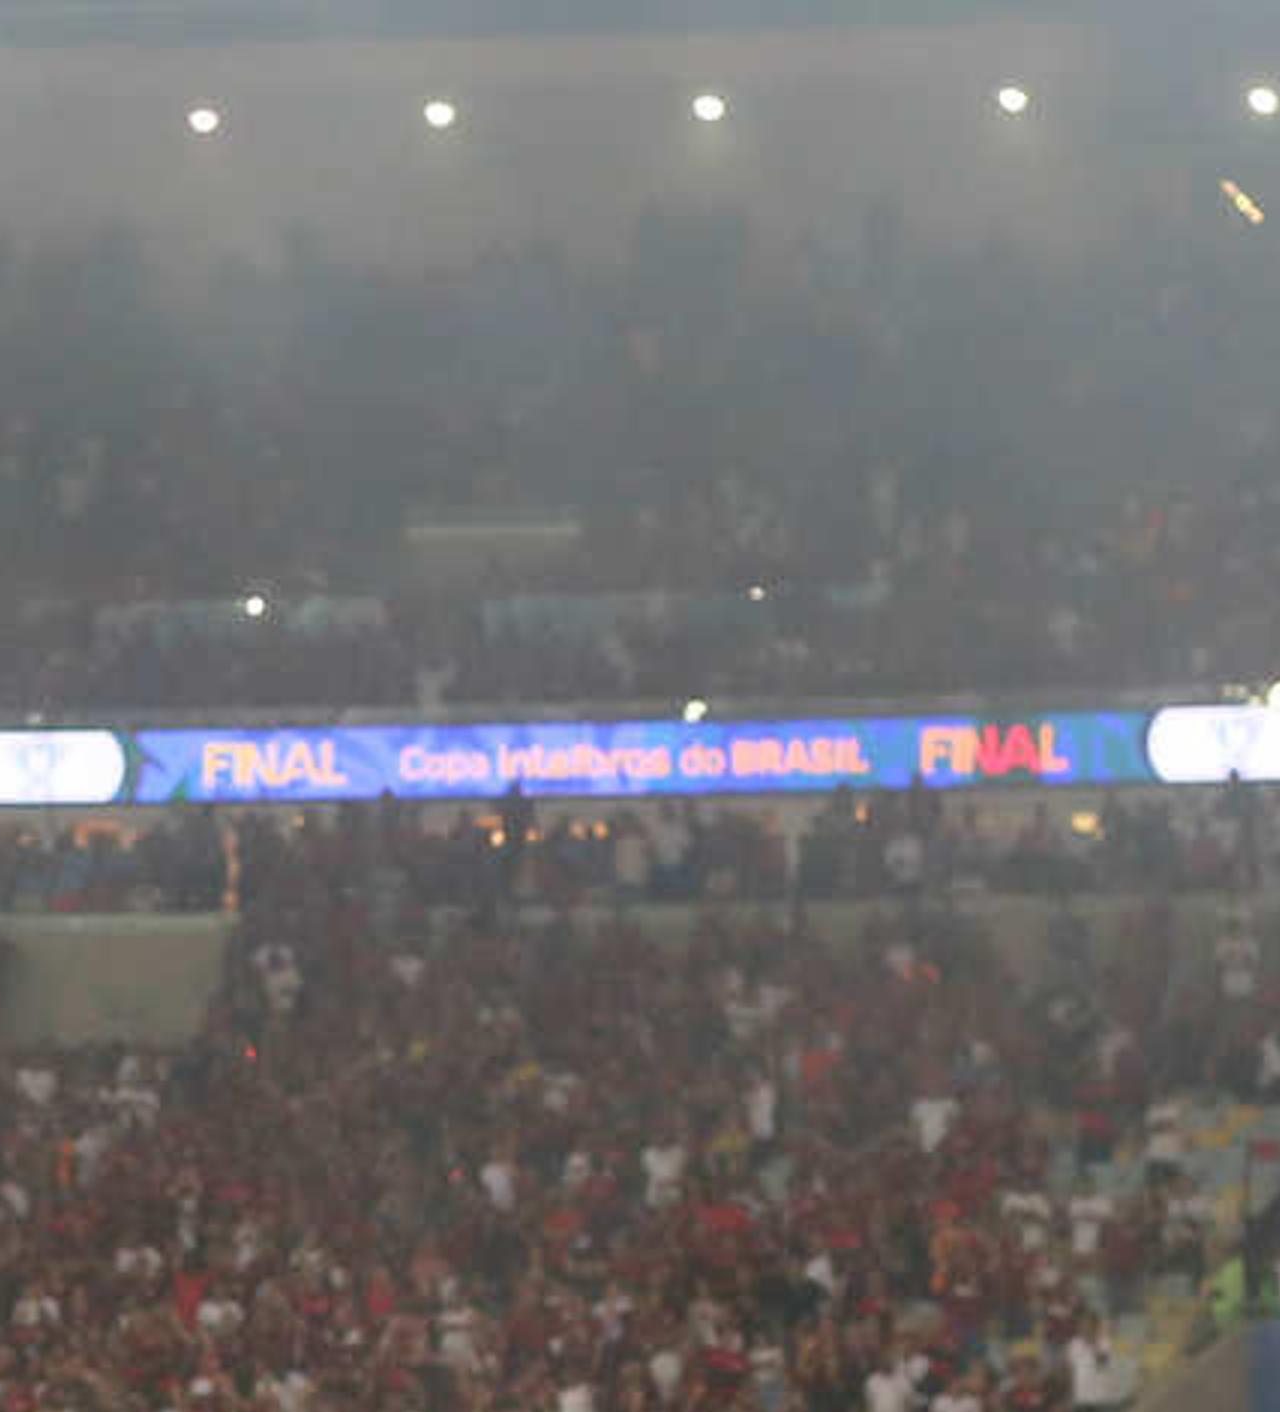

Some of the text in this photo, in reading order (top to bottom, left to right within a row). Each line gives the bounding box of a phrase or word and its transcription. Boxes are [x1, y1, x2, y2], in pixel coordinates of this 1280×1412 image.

[202, 739, 348, 788] FINAL
[400, 745, 489, 785] Copa
[680, 743, 726, 776] do
[731, 737, 870, 776] BRASIL
[919, 722, 1069, 776] FINAL
